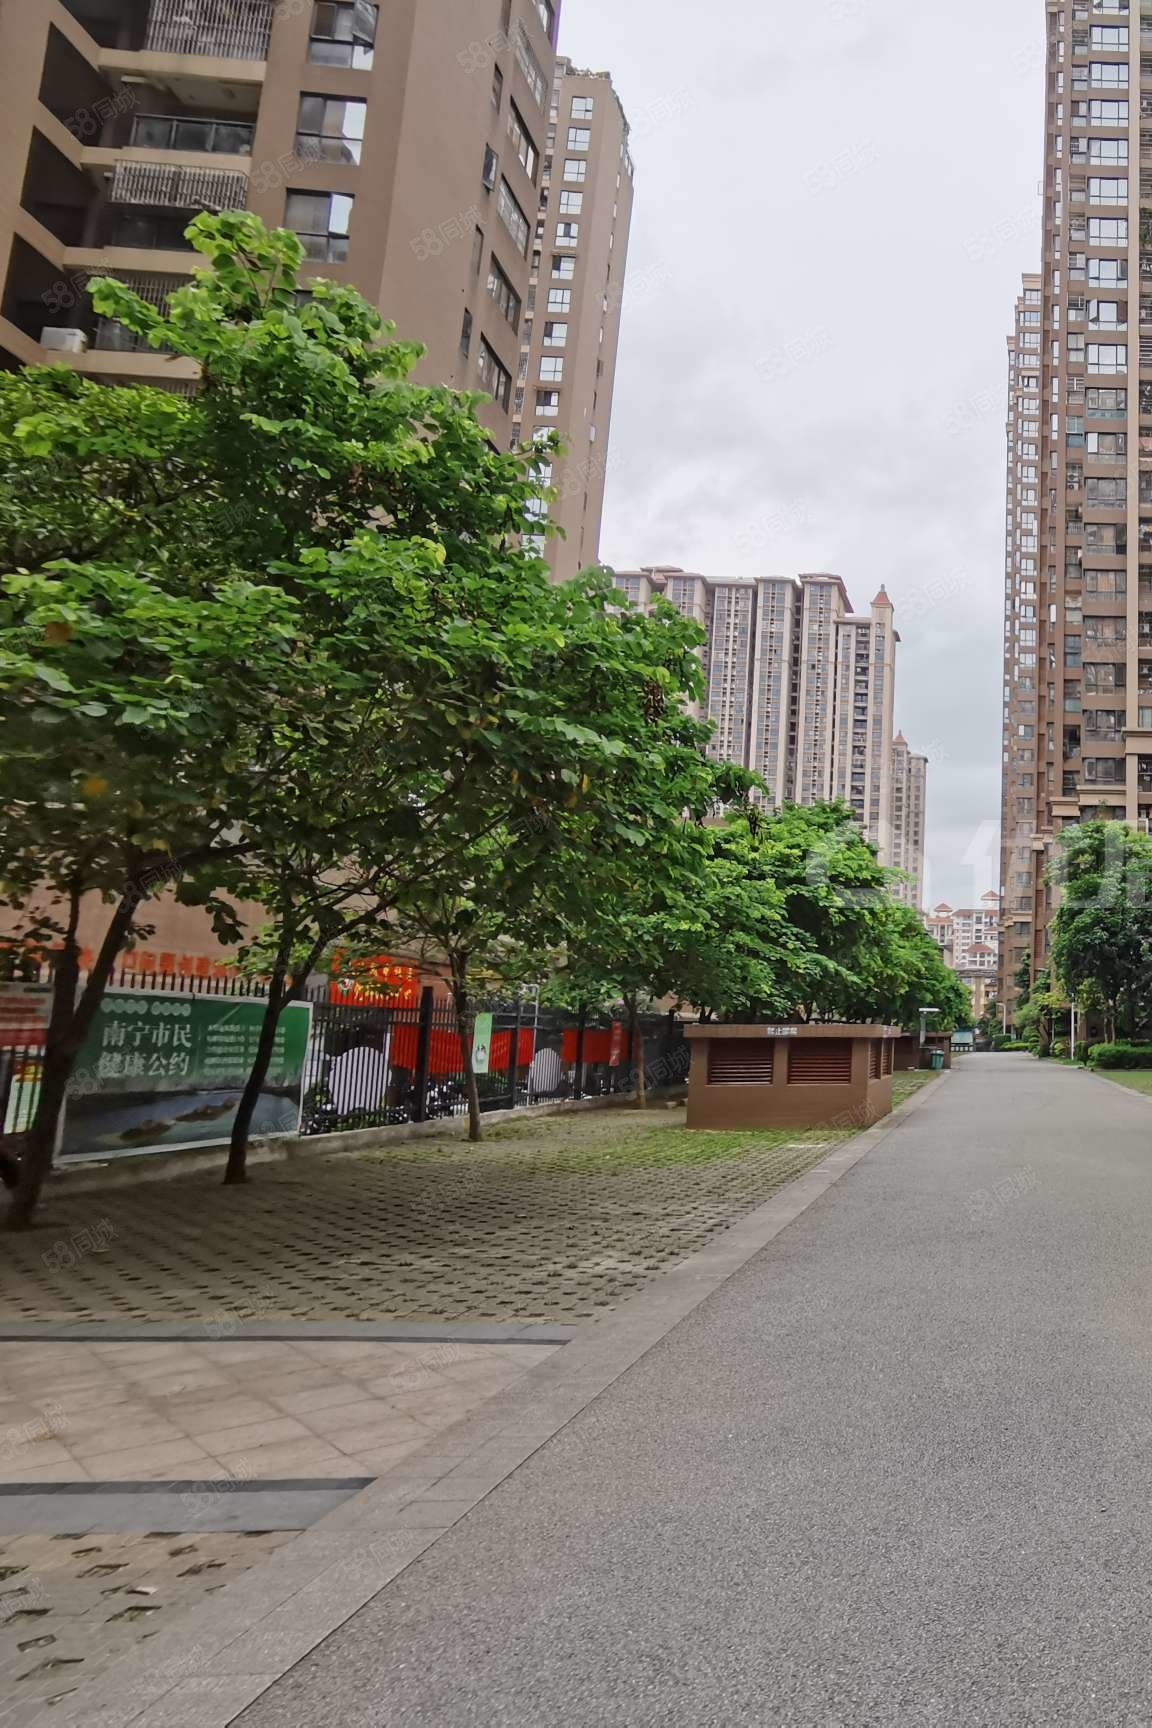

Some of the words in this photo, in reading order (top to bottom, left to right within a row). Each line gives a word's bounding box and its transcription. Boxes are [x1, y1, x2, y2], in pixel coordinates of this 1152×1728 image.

[102, 1021, 193, 1048] 南宁市民
[98, 1052, 190, 1077] 健康公约
